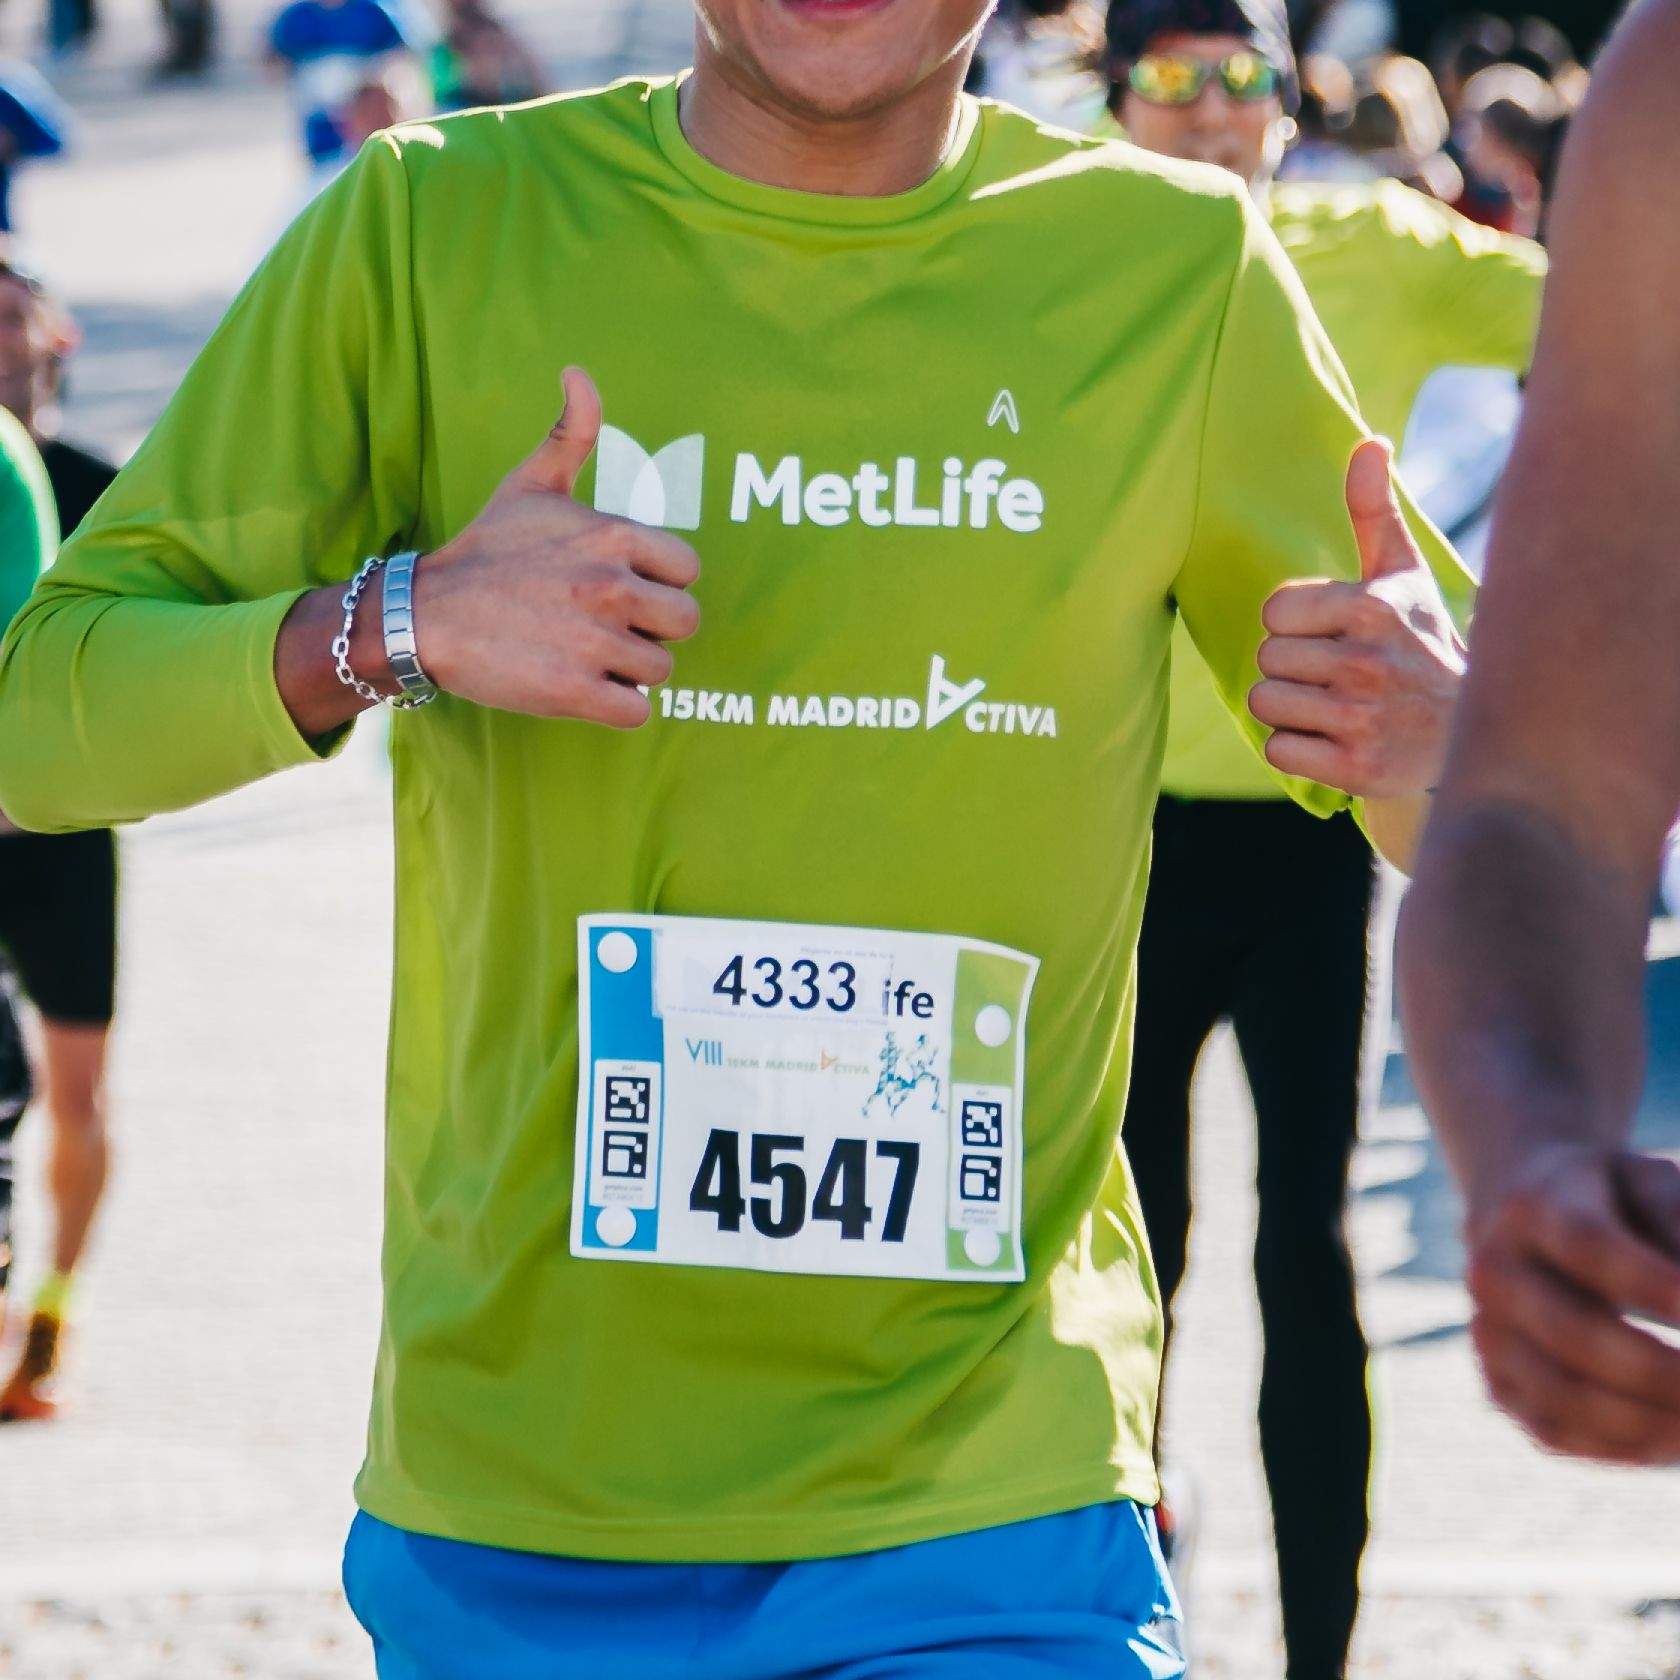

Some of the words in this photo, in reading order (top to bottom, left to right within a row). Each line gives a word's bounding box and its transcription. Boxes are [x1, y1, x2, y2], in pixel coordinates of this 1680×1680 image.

[730, 452, 1045, 532] MetLife
[658, 688, 754, 726] 15KM
[712, 954, 857, 1013] 4333
[684, 1036, 723, 1067] VIII
[688, 1127, 921, 1244] 4547
